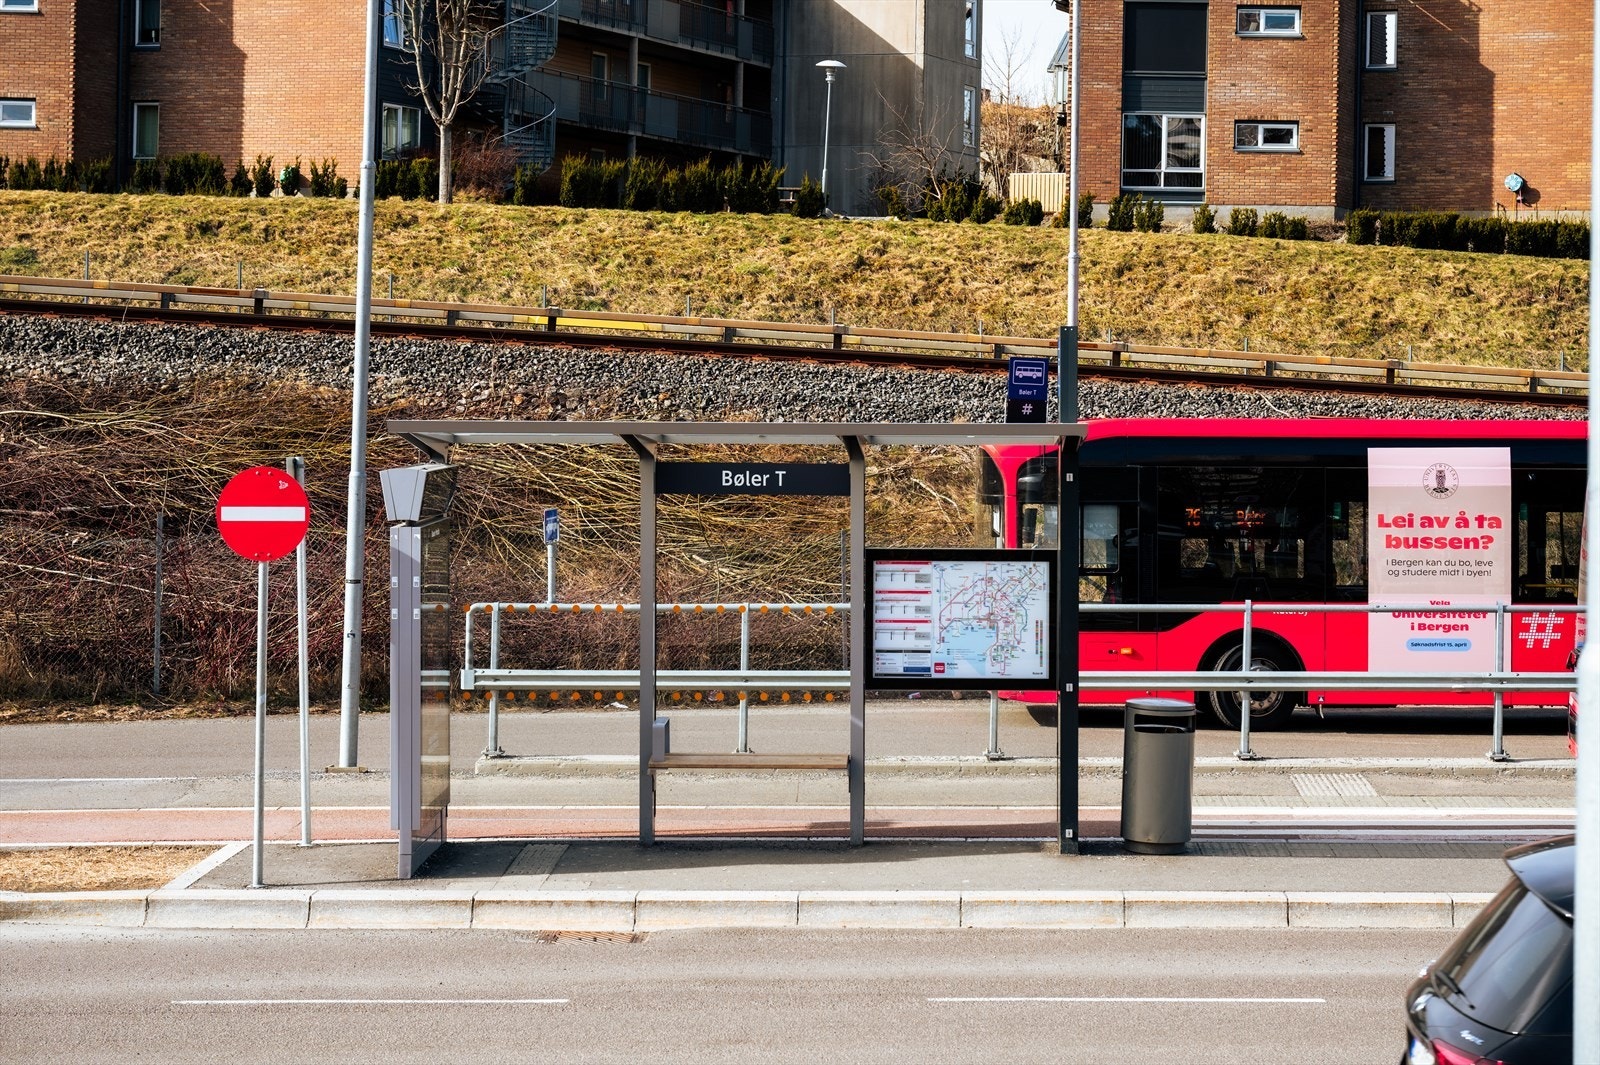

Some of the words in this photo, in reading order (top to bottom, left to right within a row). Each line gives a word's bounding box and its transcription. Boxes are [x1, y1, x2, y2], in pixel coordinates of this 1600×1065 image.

[722, 470, 770, 486] Bøler
[775, 471, 786, 486] T
[1377, 513, 1415, 529] Lei
[1419, 515, 1450, 529] av
[1455, 510, 1470, 529] å
[1475, 514, 1503, 529] ta
[1385, 534, 1494, 550] bussen?
[1391, 558, 1424, 568] Bergen
[1426, 558, 1442, 567] kan
[1444, 558, 1457, 567] du
[1458, 558, 1473, 568] bo,
[1474, 559, 1494, 567] leve
[1387, 568, 1400, 577] og
[1402, 568, 1438, 577] studere
[1439, 568, 1460, 577] midt
[1466, 568, 1492, 578] byen!
[1410, 622, 1416, 631] i
[1417, 622, 1470, 633] Bergen
